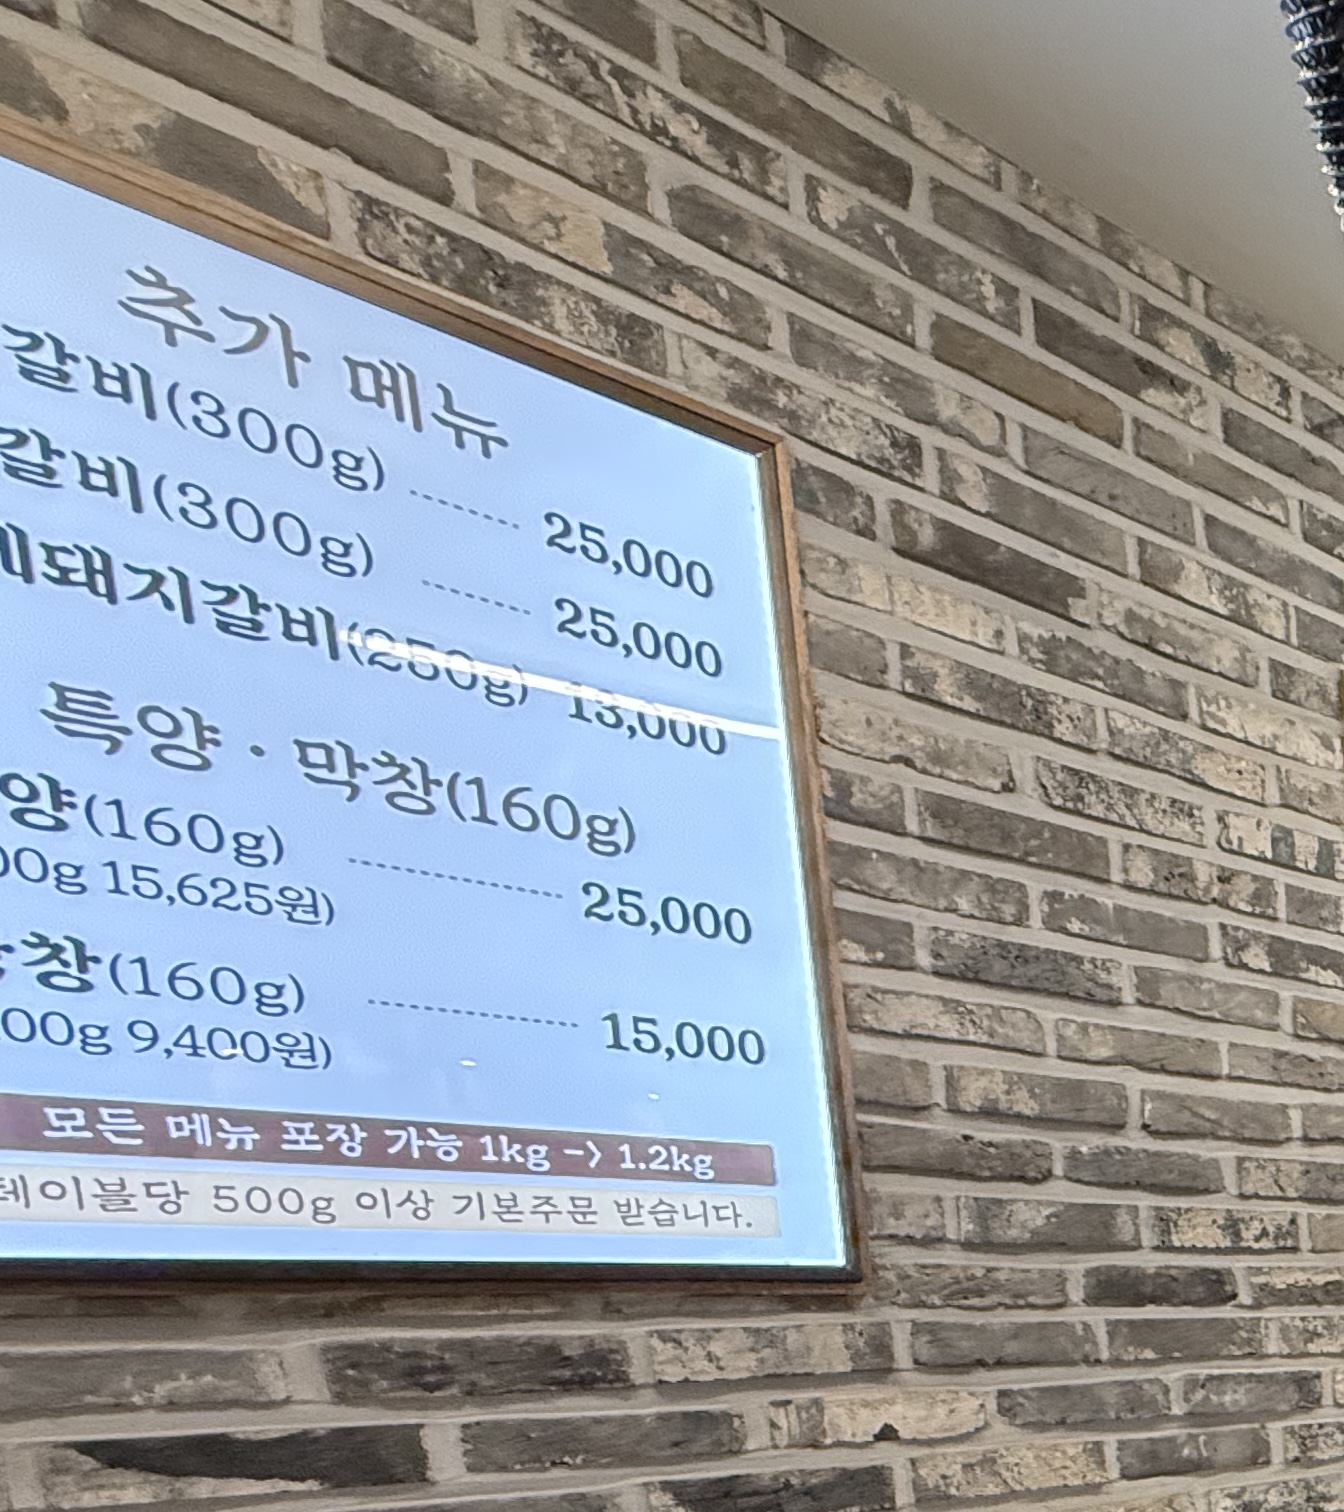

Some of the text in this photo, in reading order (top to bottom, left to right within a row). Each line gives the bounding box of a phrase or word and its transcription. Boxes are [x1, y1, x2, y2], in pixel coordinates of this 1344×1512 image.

[117, 264, 509, 460] 추가 메뉴
[2, 323, 714, 599] 갈비(300g) 25,000
[555, 597, 723, 678] 25,000
[39, 681, 223, 771] 특양
[293, 739, 636, 857] 막창(160g)
[0, 772, 752, 946] 양(160g) 25,000
[103, 860, 335, 926] 15,625원)
[0, 931, 767, 1067] 창(160g) 15,000
[127, 1020, 332, 1070] 9,400원)
[43, 1106, 145, 1146] 모든
[165, 1112, 260, 1151] 메뉴
[280, 1120, 368, 1158] 포장
[384, 1126, 463, 1162] 가능
[480, 1135, 550, 1172] 1kg
[618, 1143, 715, 1180] 1.2kg
[212, 1184, 338, 1225] 500g
[356, 1187, 434, 1222] 이상
[453, 1190, 598, 1225] 기본주문
[613, 1196, 753, 1229] 받습니다.
